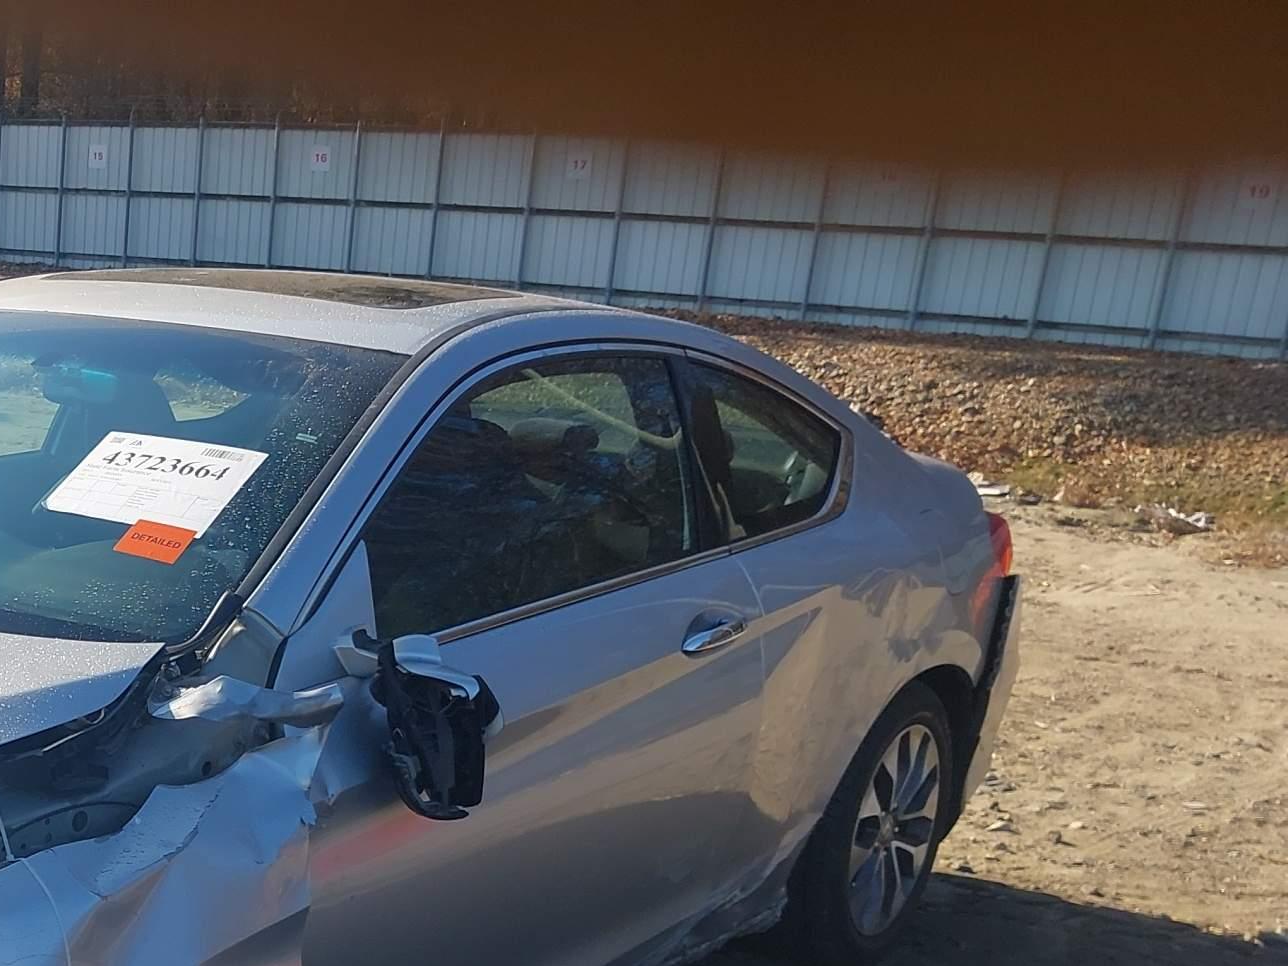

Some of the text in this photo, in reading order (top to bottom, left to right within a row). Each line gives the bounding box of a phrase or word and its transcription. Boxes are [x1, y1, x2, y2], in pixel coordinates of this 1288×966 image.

[93, 152, 104, 160] 15
[315, 153, 328, 163] 16
[573, 160, 588, 170] 17
[1249, 184, 1271, 199] 19
[102, 450, 231, 480] 43723664
[131, 532, 182, 549] DETAILED
